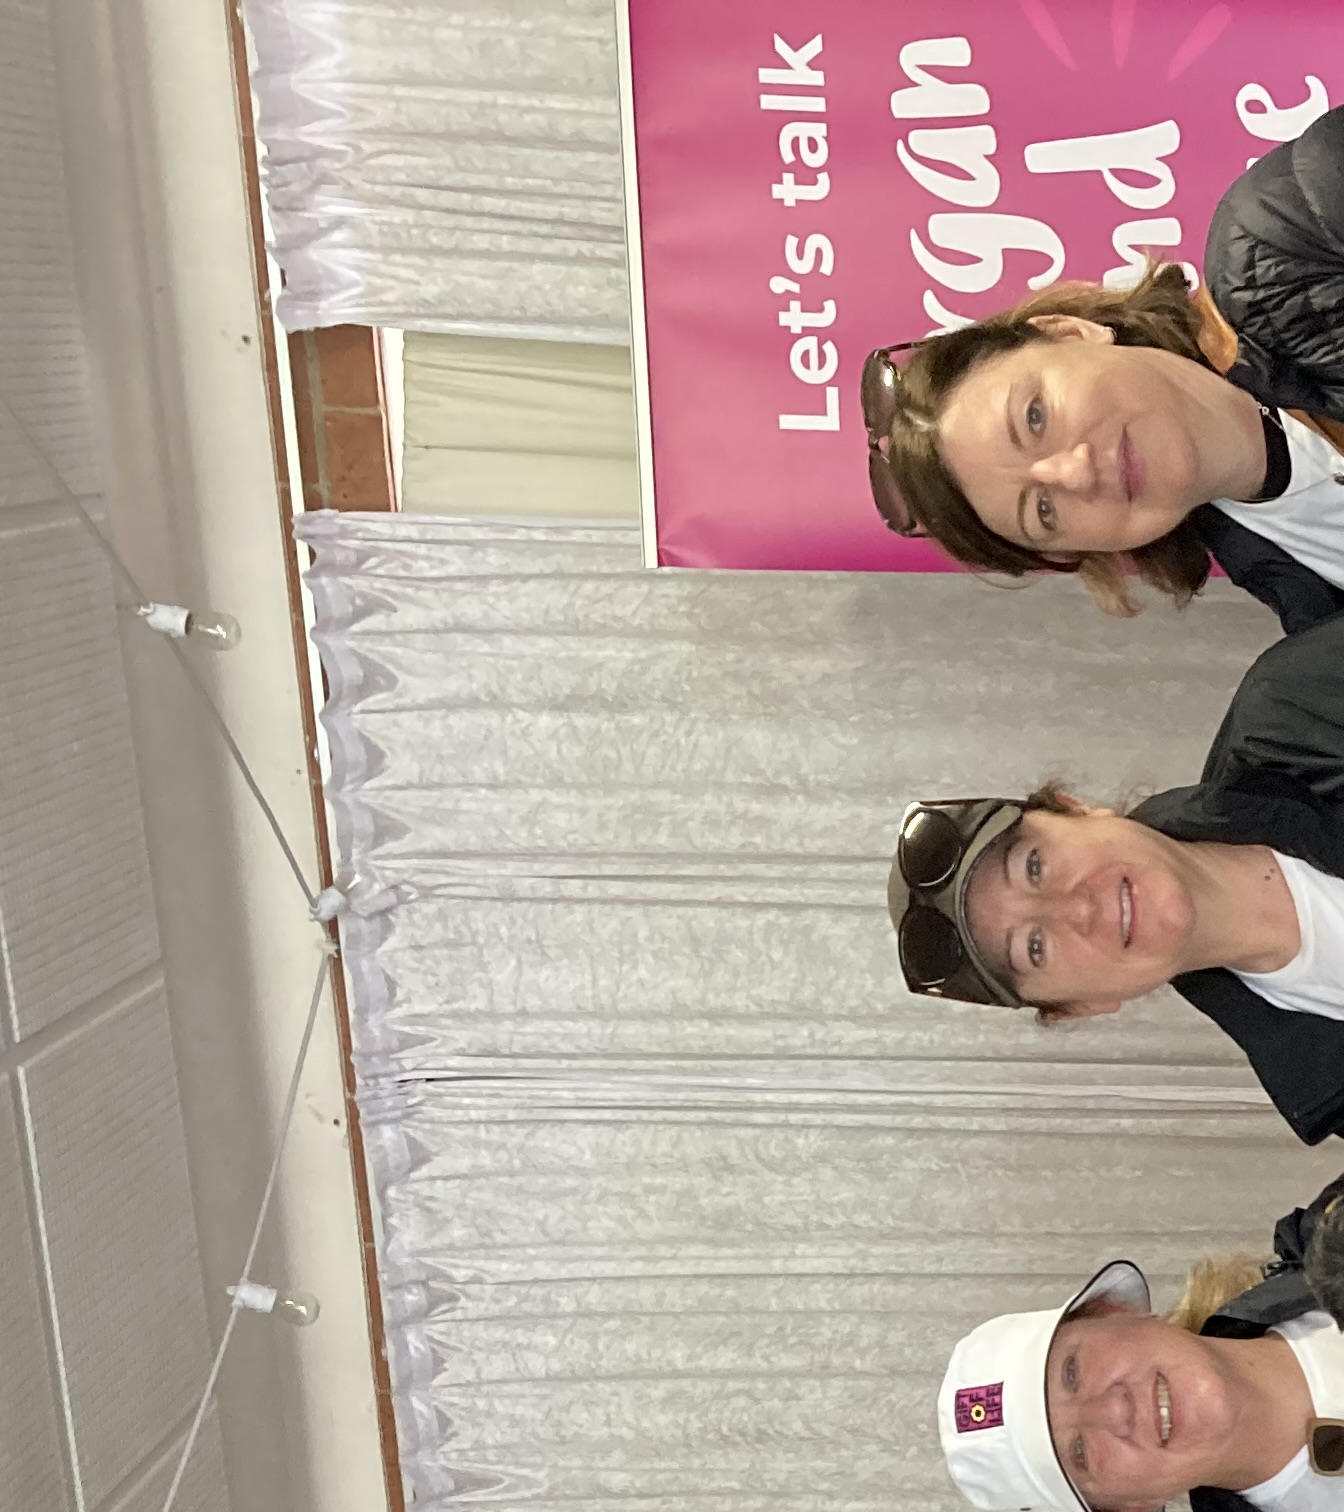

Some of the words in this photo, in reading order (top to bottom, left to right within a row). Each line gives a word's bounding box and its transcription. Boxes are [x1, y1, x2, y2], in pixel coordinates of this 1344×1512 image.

[758, 33, 830, 207] talk
[891, 36, 1066, 339] rgan
[1024, 119, 1199, 292] nd
[769, 233, 840, 432] Let’s
